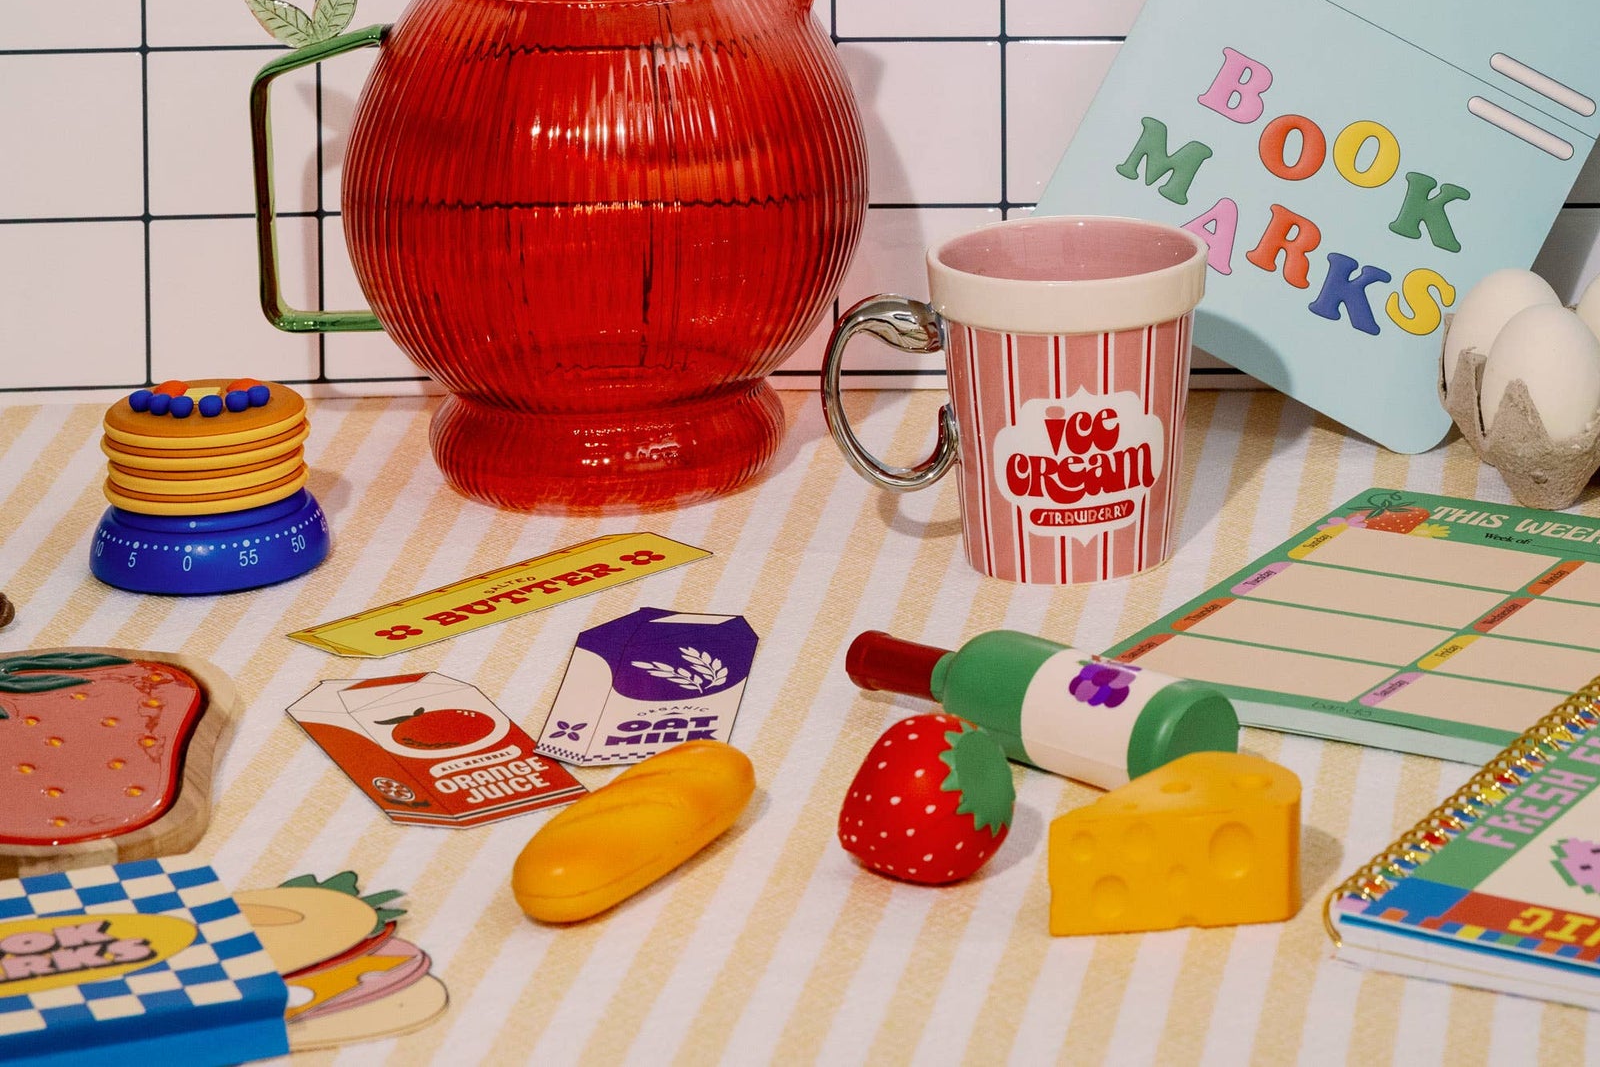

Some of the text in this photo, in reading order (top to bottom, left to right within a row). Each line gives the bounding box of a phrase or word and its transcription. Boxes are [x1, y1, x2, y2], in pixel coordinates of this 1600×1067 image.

[1197, 47, 1471, 253] BOOK
[1116, 116, 1456, 336] MARKS
[1036, 502, 1129, 525] STRAWBERRY
[1431, 505, 1510, 529] THIS
[1302, 532, 1334, 551] Sunday
[1484, 532, 1514, 544] Week
[127, 551, 138, 568] 5
[182, 555, 193, 572] 0
[238, 548, 259, 567] 55
[290, 534, 306, 554] 50
[483, 576, 537, 595] SALTED
[1243, 568, 1278, 587] Tuesday
[1538, 568, 1570, 587] Monday
[423, 562, 626, 627] BUTTER
[1434, 642, 1464, 659] Friday
[637, 705, 710, 717] ORGANIC
[616, 716, 719, 732] OAT
[604, 729, 719, 746] MILK
[440, 750, 513, 773] ALL NATURAL
[434, 756, 550, 794] ORANGE
[466, 772, 551, 804] JUICE
[1466, 768, 1598, 849] FRESH
[0, 920, 118, 955] OK
[0, 938, 157, 983] RKS
